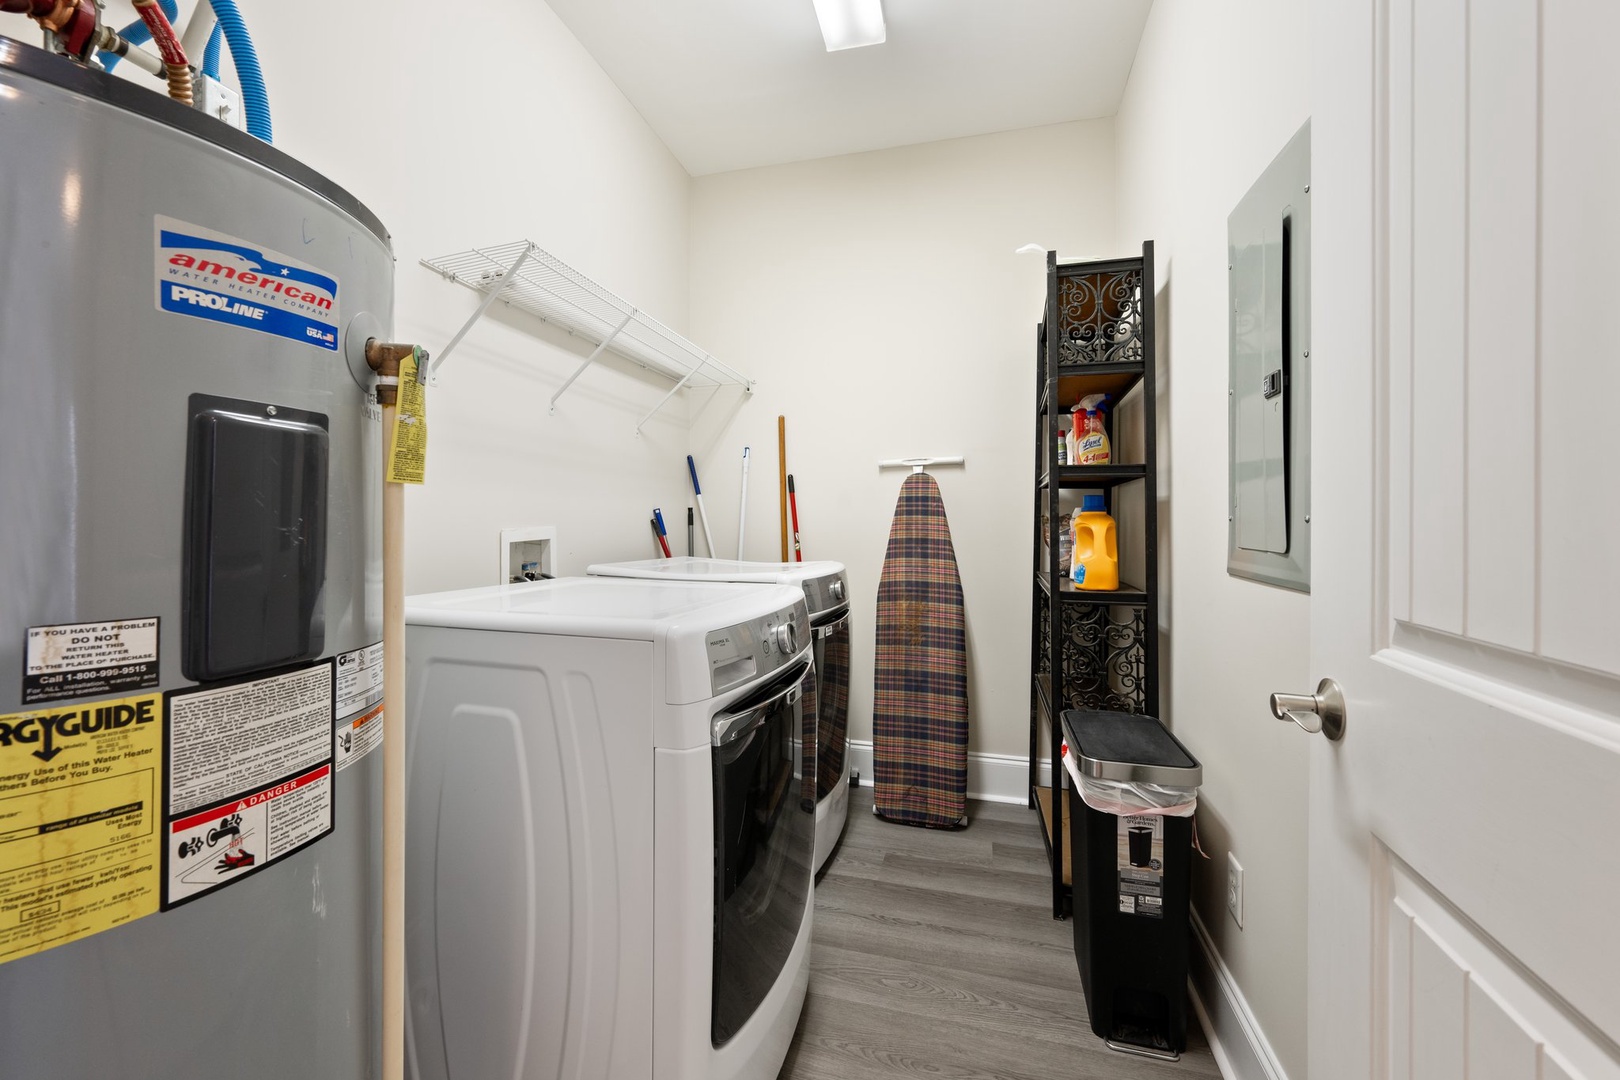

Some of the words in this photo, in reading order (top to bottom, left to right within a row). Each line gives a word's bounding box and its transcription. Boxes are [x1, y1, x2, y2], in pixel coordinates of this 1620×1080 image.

[169, 254, 332, 310] american
[169, 268, 218, 285] WATER
[229, 283, 275, 300] HEATER
[172, 286, 264, 320] PROLINE
[1082, 436, 1102, 448] Lysol
[111, 622, 155, 630] PROBLEM
[110, 654, 154, 663] PURCHASE.
[40, 675, 62, 684] Call
[66, 665, 146, 680] 1-800-999-9515
[110, 676, 140, 684] warranty
[252, 678, 280, 688] IMPORTANT
[26, 690, 74, 701] performance
[34, 768, 54, 776] Use
[72, 760, 90, 769] this
[93, 755, 121, 765] Water
[124, 748, 153, 758] Heater
[254, 757, 282, 769] CALIFORNIA
[284, 750, 299, 758] NOTICE
[31, 775, 66, 786] Before
[70, 770, 89, 778] You
[92, 765, 113, 775] Buy.
[250, 781, 297, 806] DANGER
[106, 817, 124, 826] Uses
[126, 812, 143, 821] Most
[117, 819, 142, 830] Energy
[55, 882, 94, 897] estimated
[95, 876, 118, 888] yearly
[119, 864, 153, 879] operating
[72, 875, 94, 886] fewer
